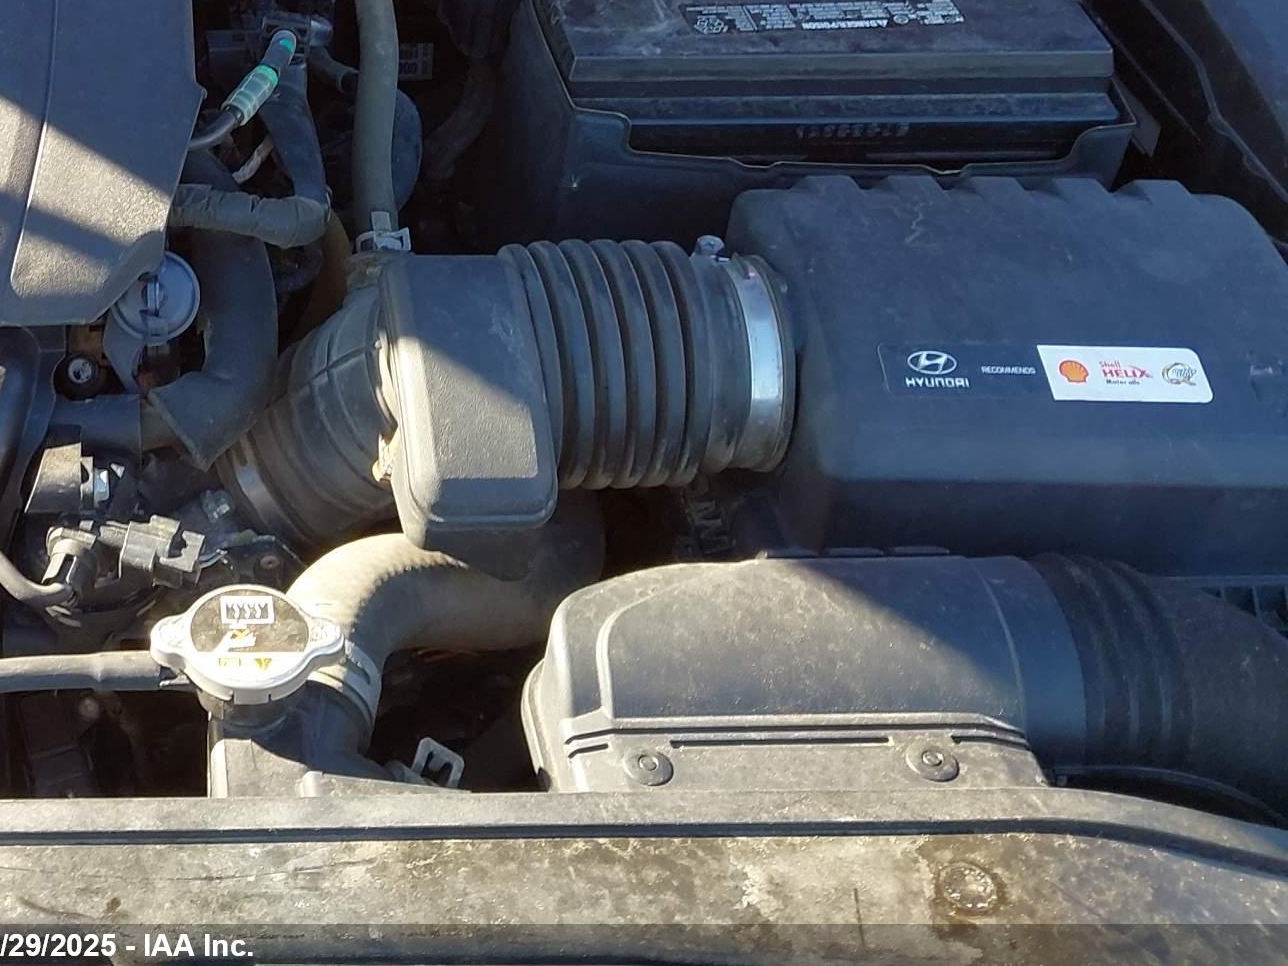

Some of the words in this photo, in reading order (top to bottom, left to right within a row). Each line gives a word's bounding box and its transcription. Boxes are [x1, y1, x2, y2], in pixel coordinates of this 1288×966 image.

[1099, 360, 1121, 368] Shell
[981, 365, 1035, 375] RECOMMENDS
[1102, 369, 1151, 378] HELIX
[905, 377, 970, 388] HYUNDAI
